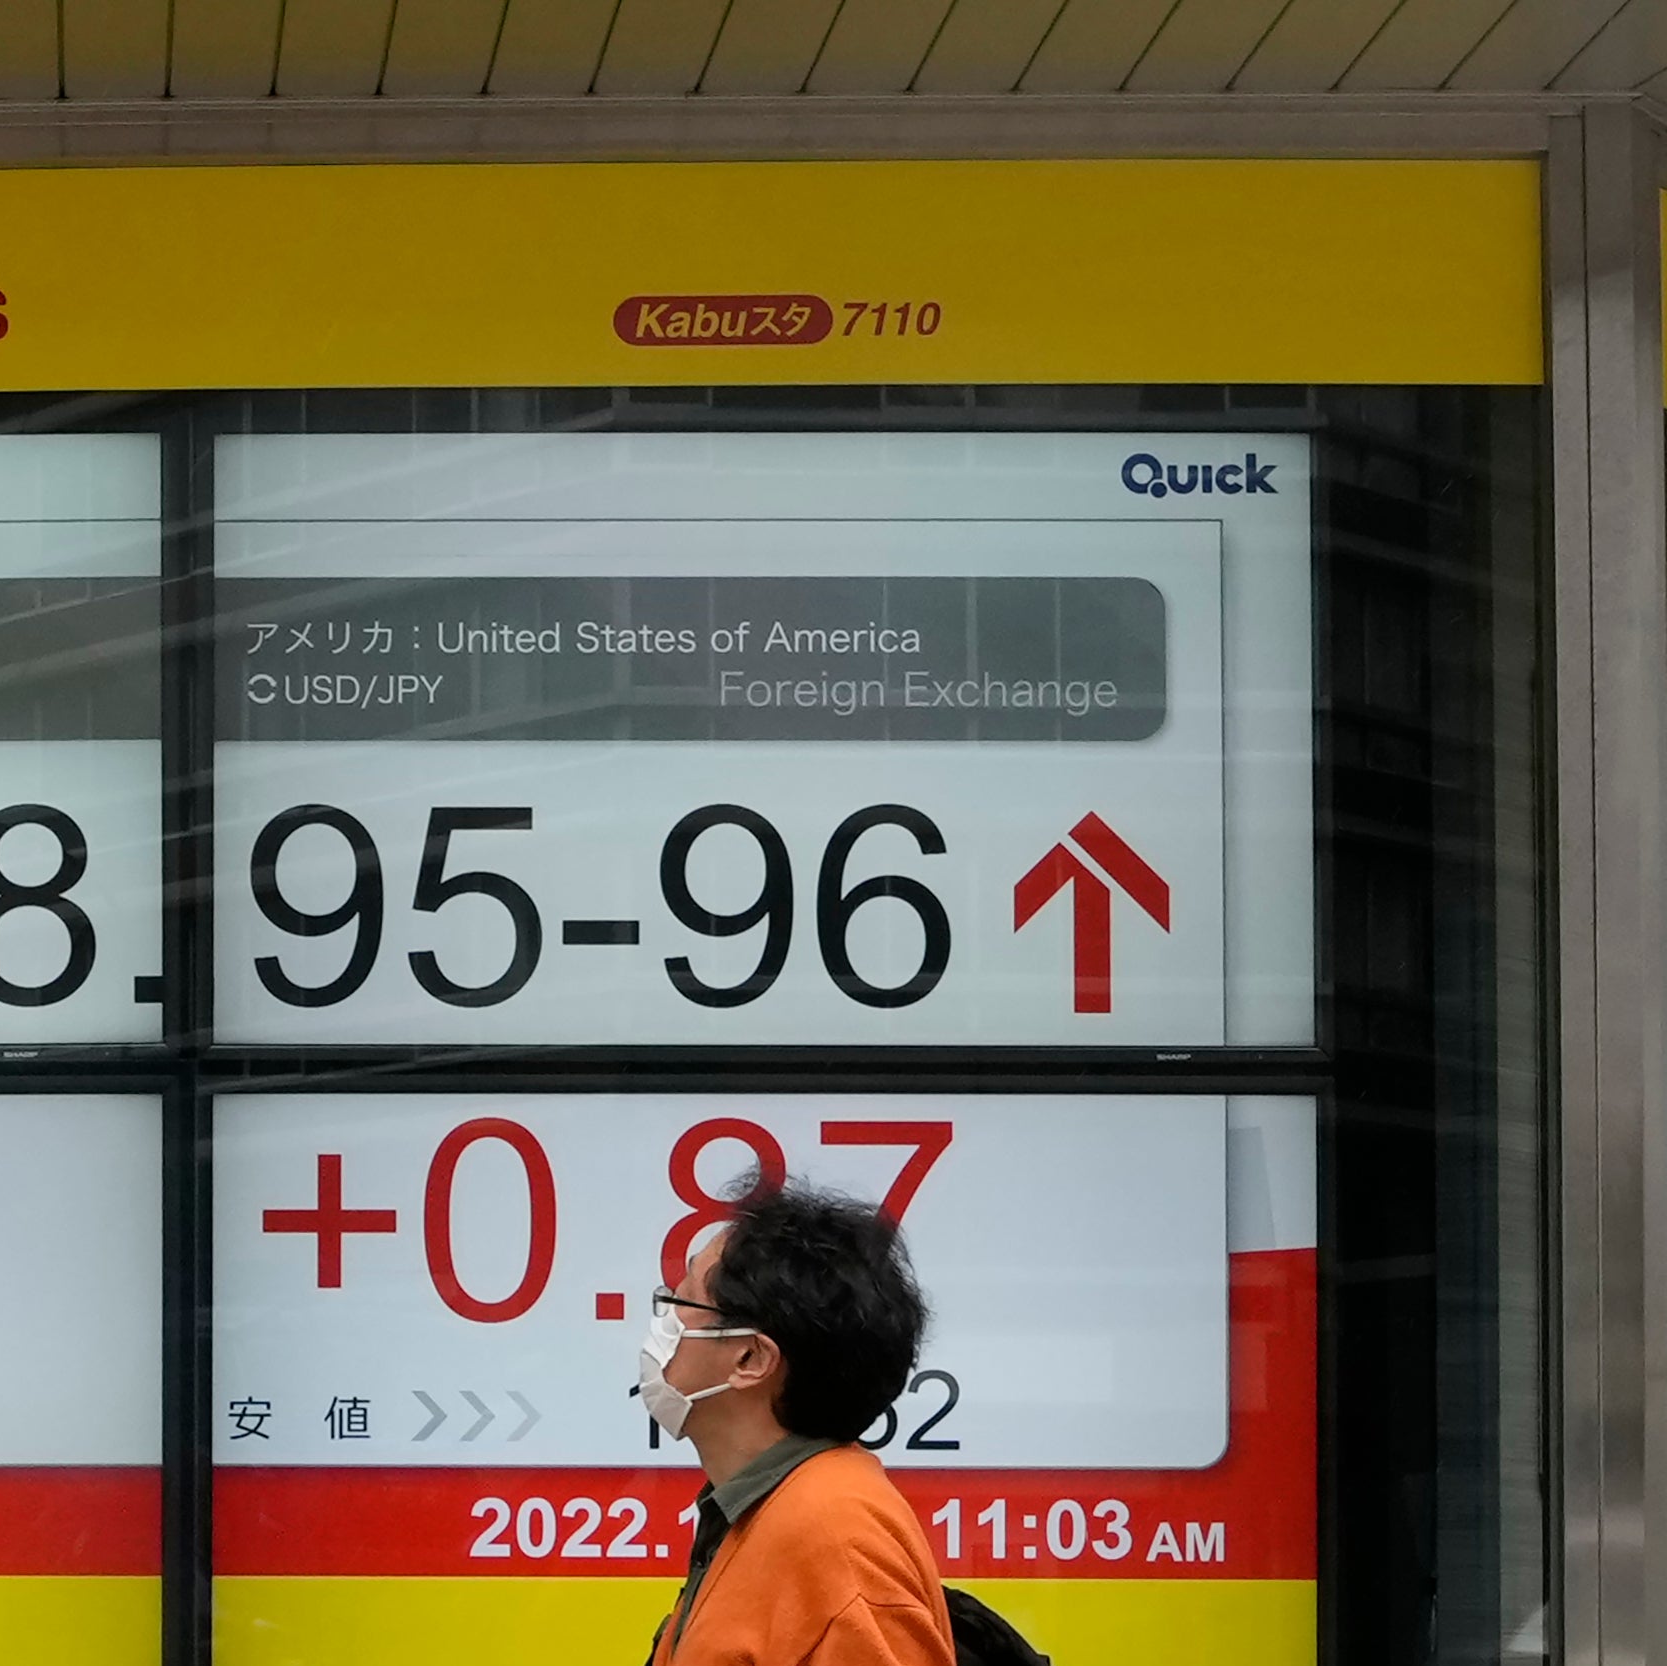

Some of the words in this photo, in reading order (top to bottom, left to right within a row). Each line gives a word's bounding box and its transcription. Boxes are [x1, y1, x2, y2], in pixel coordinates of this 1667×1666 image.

[636, 302, 811, 338] Kabuスタ
[842, 302, 942, 337] 7110
[437, 621, 560, 653] United
[576, 621, 696, 653] States
[710, 621, 750, 653] of
[764, 621, 920, 653] America
[284, 674, 444, 710] USD/JPY
[719, 671, 885, 716] Foreign
[904, 671, 1118, 716] Exchange
[263, 1117, 953, 1321] +0.87
[932, 1497, 1134, 1560] 11:03
[1146, 1521, 1226, 1562] AM
